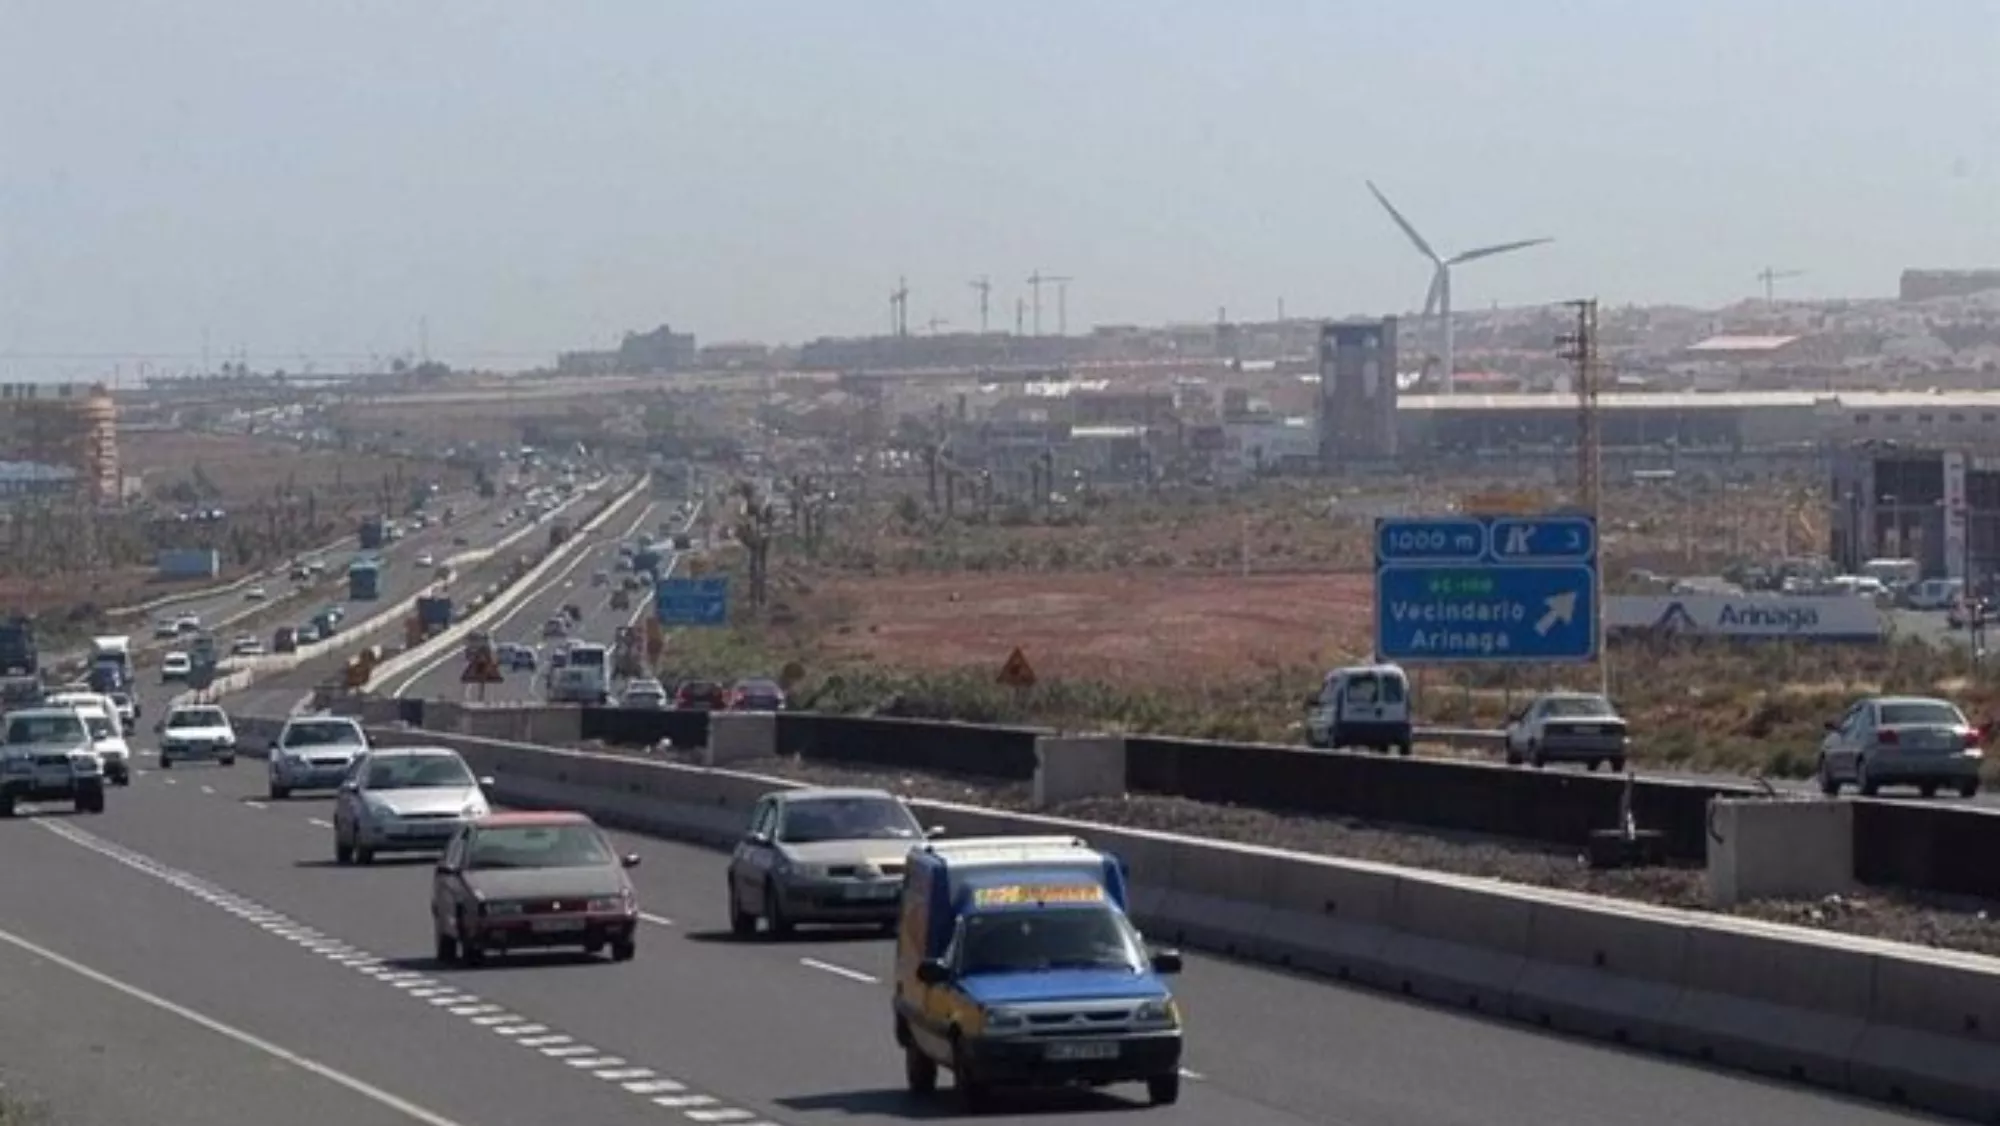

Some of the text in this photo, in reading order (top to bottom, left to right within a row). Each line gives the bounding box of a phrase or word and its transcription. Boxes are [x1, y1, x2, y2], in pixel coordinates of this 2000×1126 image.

[1390, 530, 1474, 550] 1000 m
[1390, 600, 1526, 621] Vecindario
[1718, 603, 1819, 630] Arinaga
[1411, 628, 1510, 653] Arinaga
